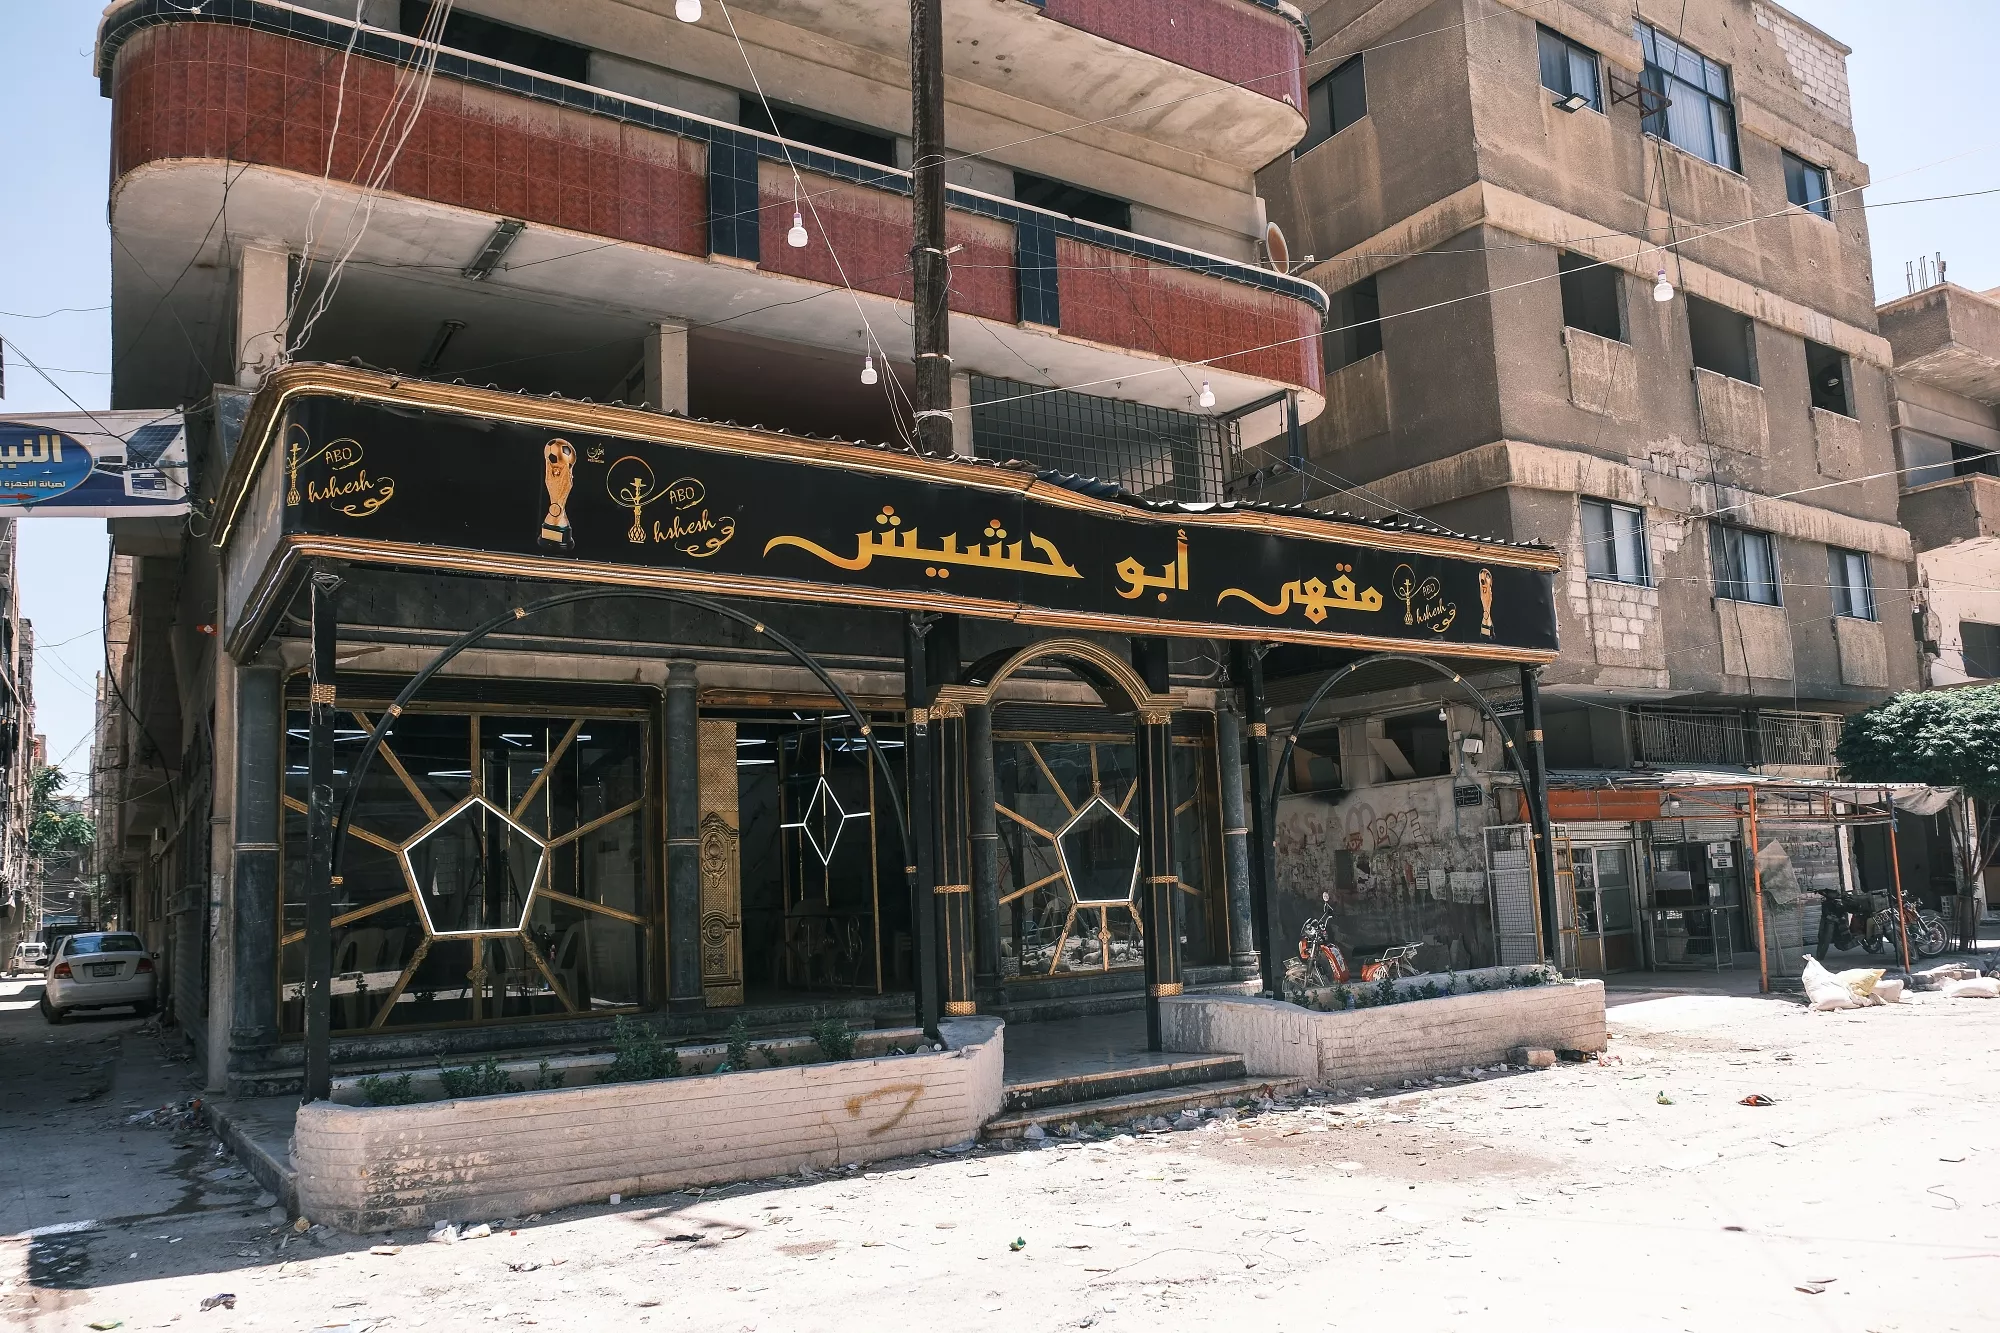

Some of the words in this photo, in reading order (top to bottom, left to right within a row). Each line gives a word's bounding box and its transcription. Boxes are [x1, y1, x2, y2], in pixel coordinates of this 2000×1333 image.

[325, 447, 352, 464] ABO
[39, 480, 66, 489] لصيانة
[308, 469, 375, 503] hshesh
[669, 486, 695, 504] ABO
[653, 509, 717, 543] hshesh
[763, 505, 1085, 579] حشيش
[1115, 528, 1190, 602] أبو
[1422, 583, 1436, 597] ABO
